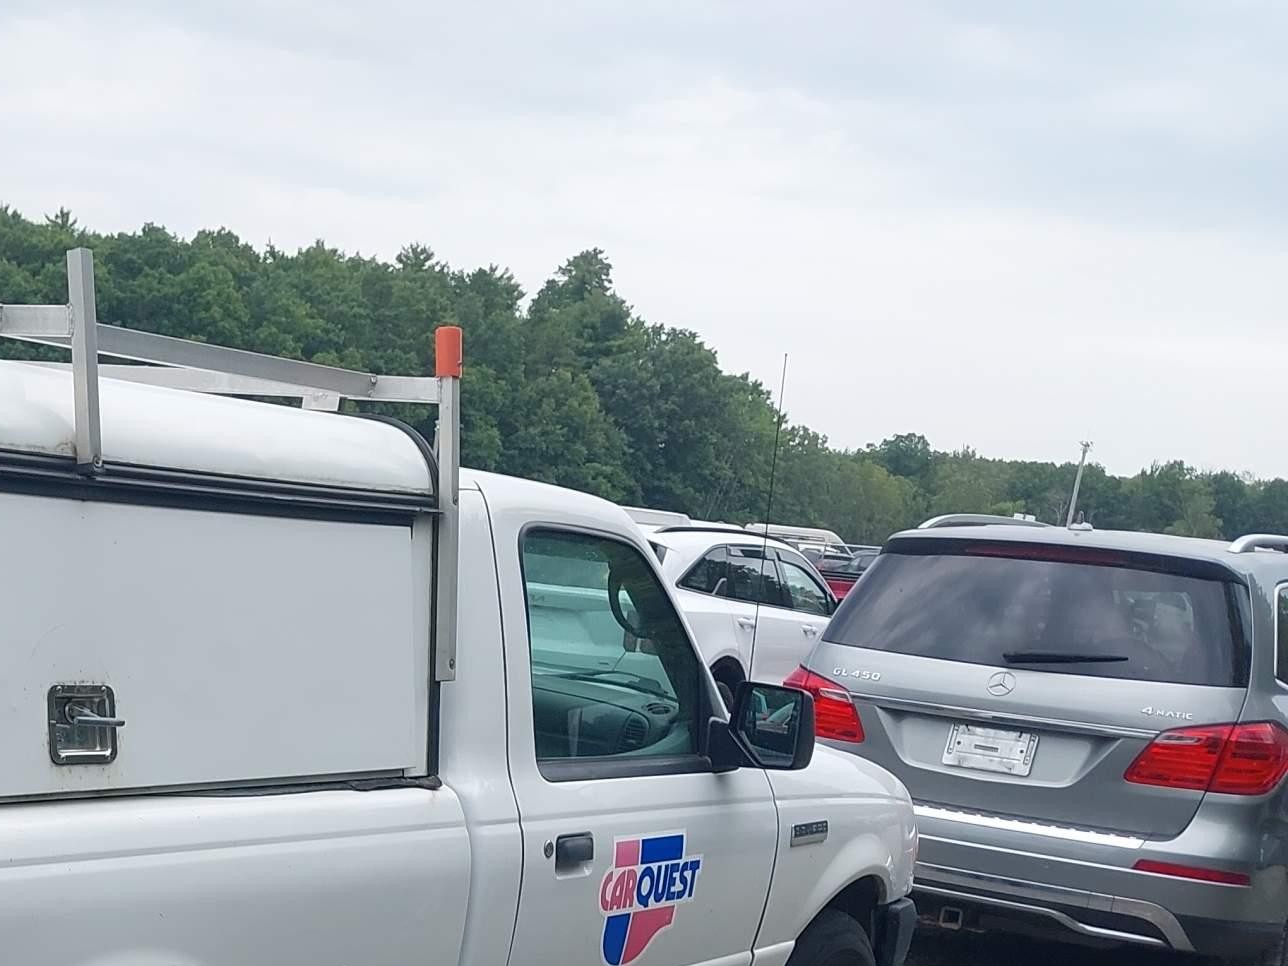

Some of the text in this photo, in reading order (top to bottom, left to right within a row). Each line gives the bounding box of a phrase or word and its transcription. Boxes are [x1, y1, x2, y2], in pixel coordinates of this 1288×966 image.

[833, 667, 881, 681] GL 450
[600, 859, 701, 911] CARQUEST
